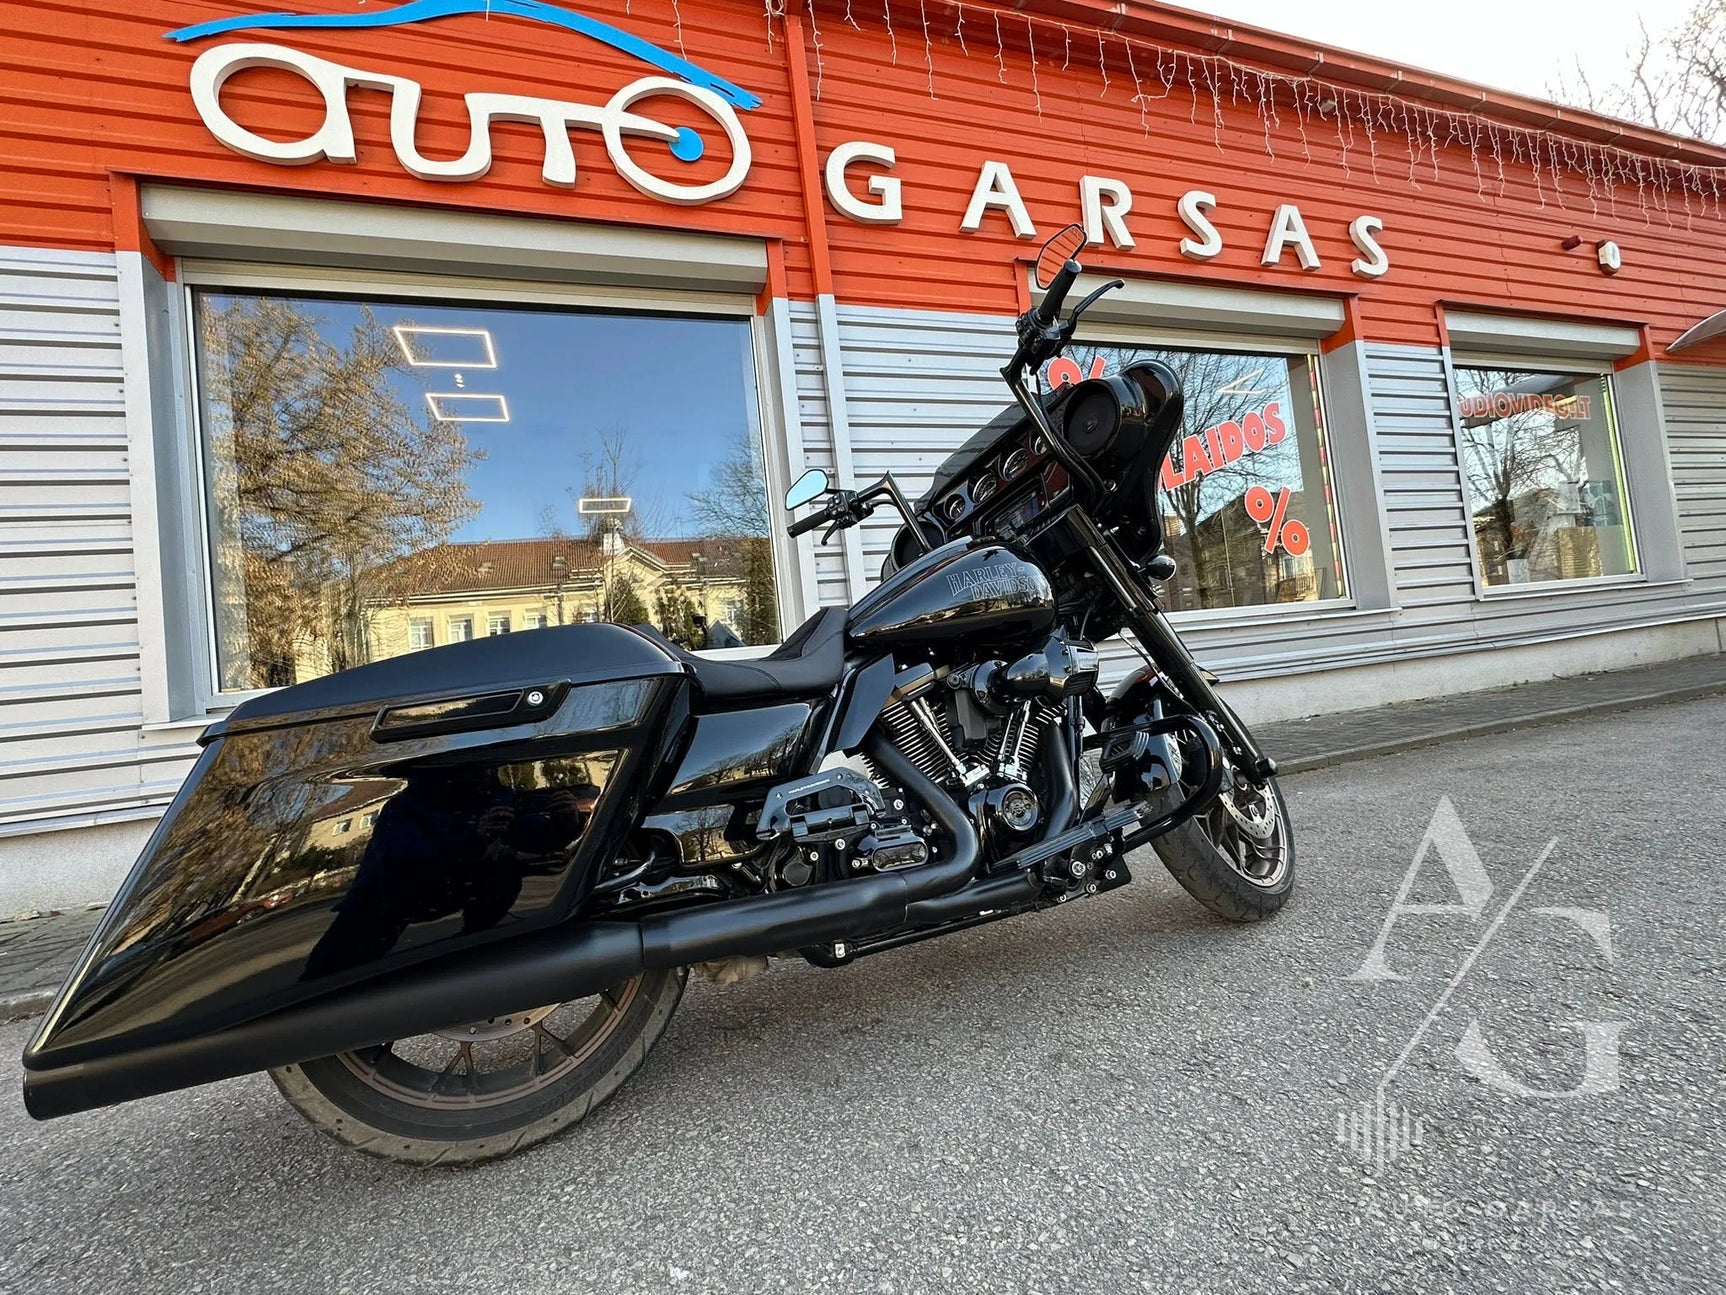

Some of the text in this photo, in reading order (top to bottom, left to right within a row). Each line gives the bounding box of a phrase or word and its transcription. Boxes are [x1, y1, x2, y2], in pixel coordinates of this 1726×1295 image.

[824, 141, 1389, 279] GARSAS
[1458, 392, 1591, 420] UDIOVIDEO.LT
[1157, 402, 1287, 491] LAIDOS
[1244, 485, 1310, 556] %
